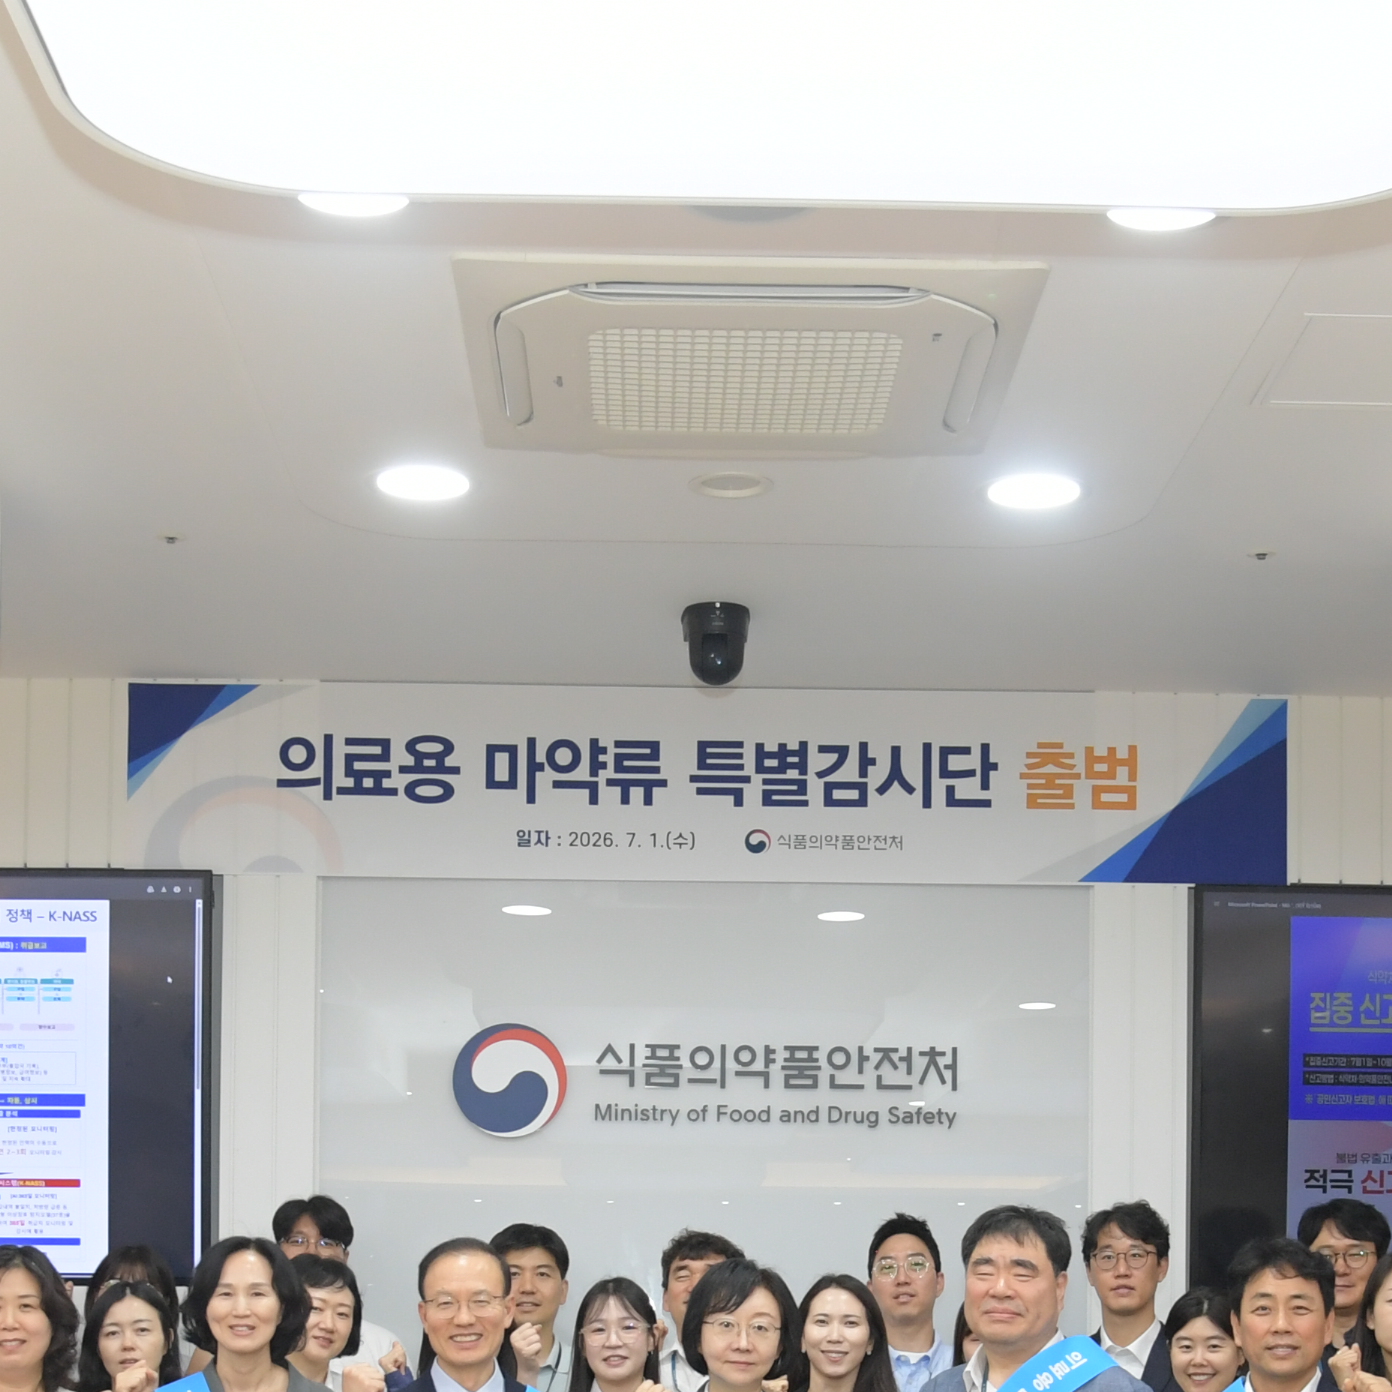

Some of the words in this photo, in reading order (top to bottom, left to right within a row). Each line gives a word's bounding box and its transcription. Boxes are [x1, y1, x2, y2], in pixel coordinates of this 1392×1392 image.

[276, 733, 461, 804] 의료용
[485, 737, 668, 806] 마약류
[689, 740, 999, 809] 특별감시단
[1019, 741, 1138, 811] 출범
[516, 829, 551, 849] 일자
[568, 831, 619, 849] 2026.
[626, 832, 642, 849] 7.
[776, 832, 904, 853] 식품의약품안전처
[5, 908, 33, 923] 정책
[48, 910, 98, 923] K-NASS
[1310, 992, 1354, 1025] 집중
[595, 1042, 959, 1092] 식품의약품안전처
[594, 1103, 680, 1127] Ministry
[687, 1104, 709, 1124] of
[716, 1105, 771, 1124] Food
[779, 1106, 819, 1125] and
[827, 1106, 879, 1128] Drug
[887, 1107, 958, 1129] Safety
[1336, 1153, 1358, 1164] 불법
[1360, 1153, 1392, 1165] 유출과
[1304, 1169, 1354, 1194] 적극
[1032, 1349, 1088, 1392] 의료용
